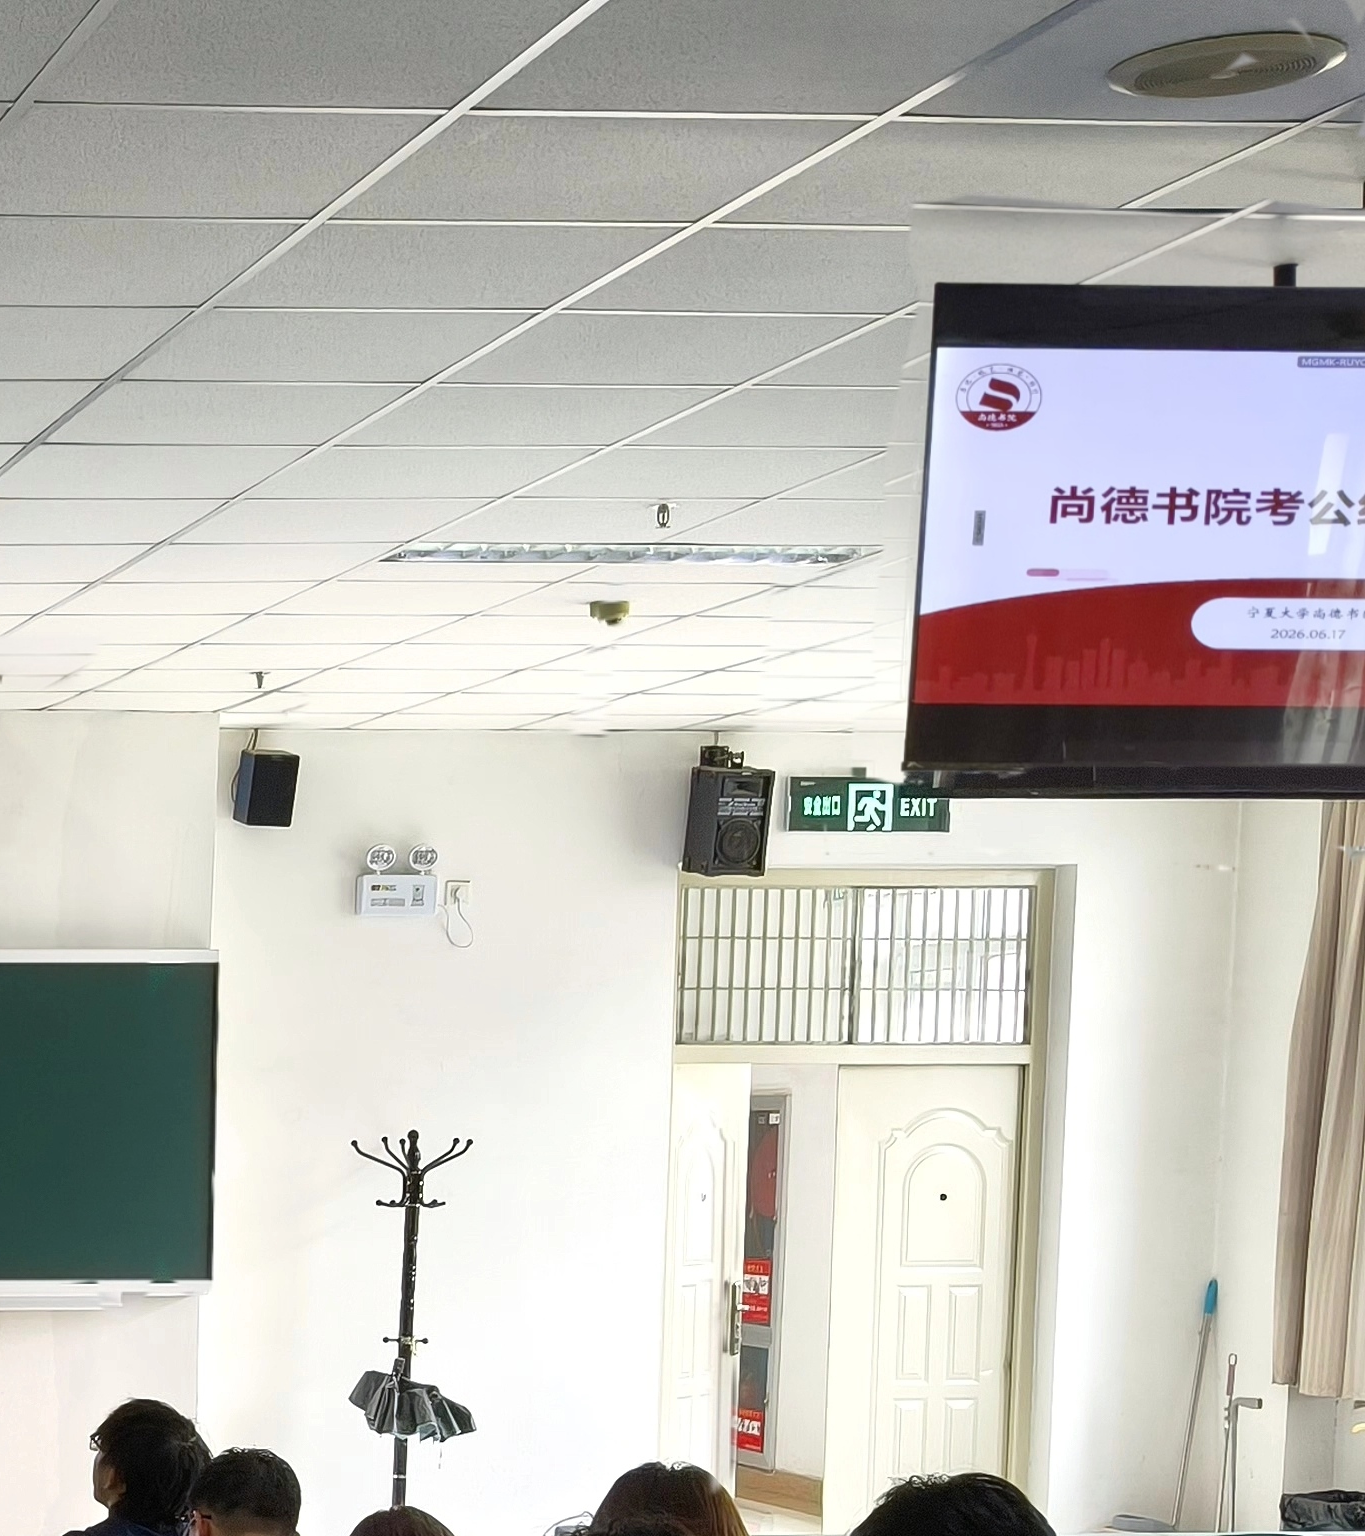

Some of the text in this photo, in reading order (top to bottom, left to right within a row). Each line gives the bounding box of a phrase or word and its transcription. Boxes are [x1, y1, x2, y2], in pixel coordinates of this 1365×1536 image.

[1248, 606, 1365, 620] 宁夏大学尚德书
[1270, 629, 1346, 640] 2026.06.17
[900, 797, 937, 817] EXIT
